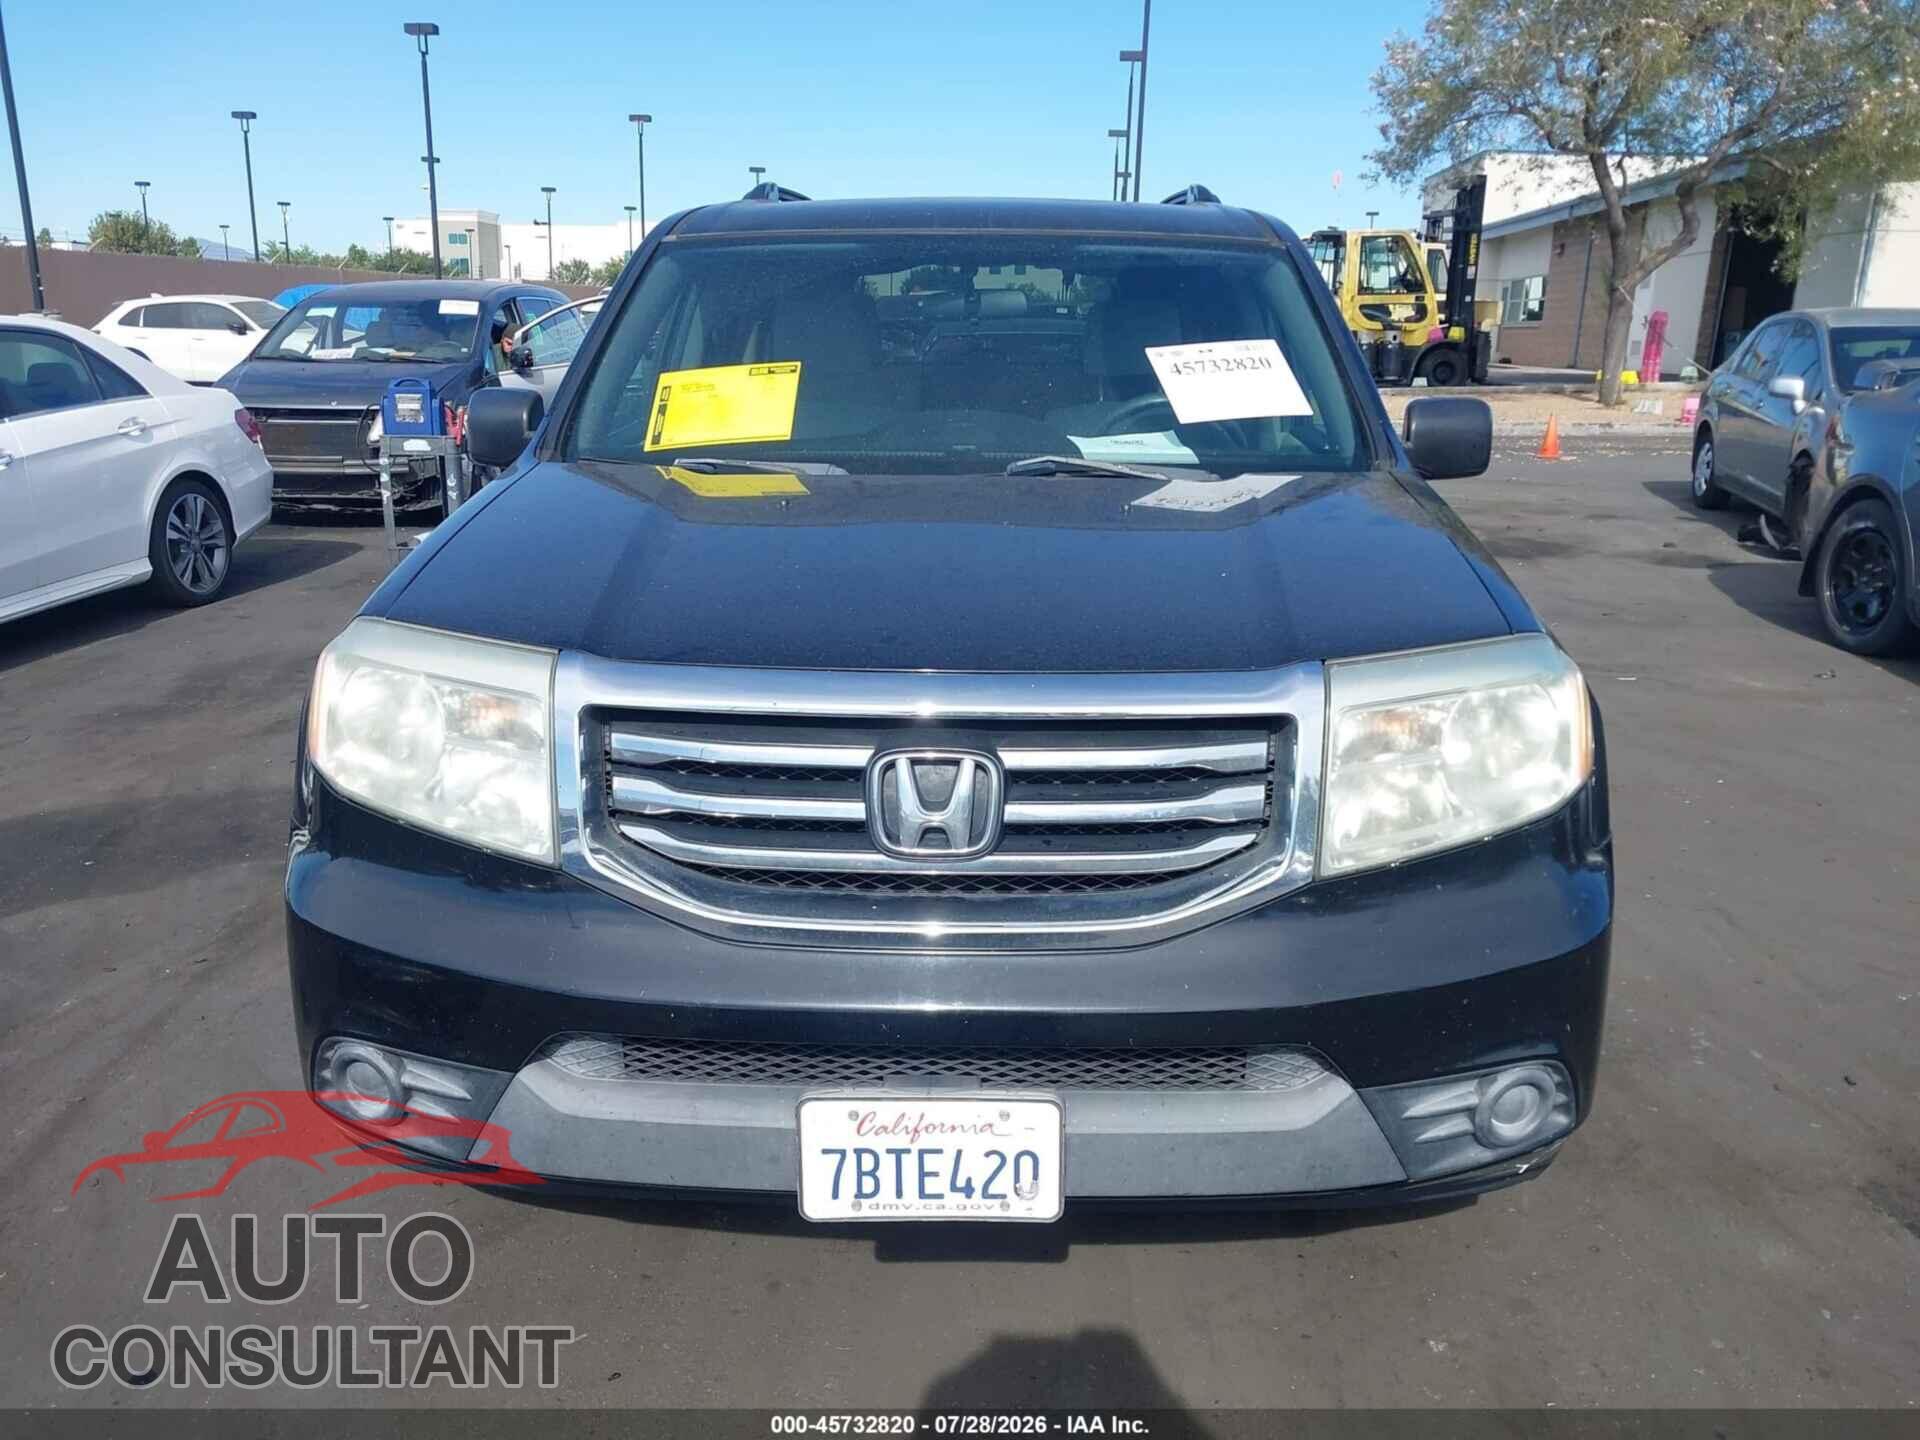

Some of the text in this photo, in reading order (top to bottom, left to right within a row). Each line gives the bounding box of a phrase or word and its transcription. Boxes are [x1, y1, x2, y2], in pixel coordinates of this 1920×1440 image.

[1170, 356, 1273, 376] 45732820
[855, 1110, 1012, 1144] California
[821, 1148, 1040, 1200] 7BTE420
[868, 1202, 997, 1212] dmv.ca.gov
